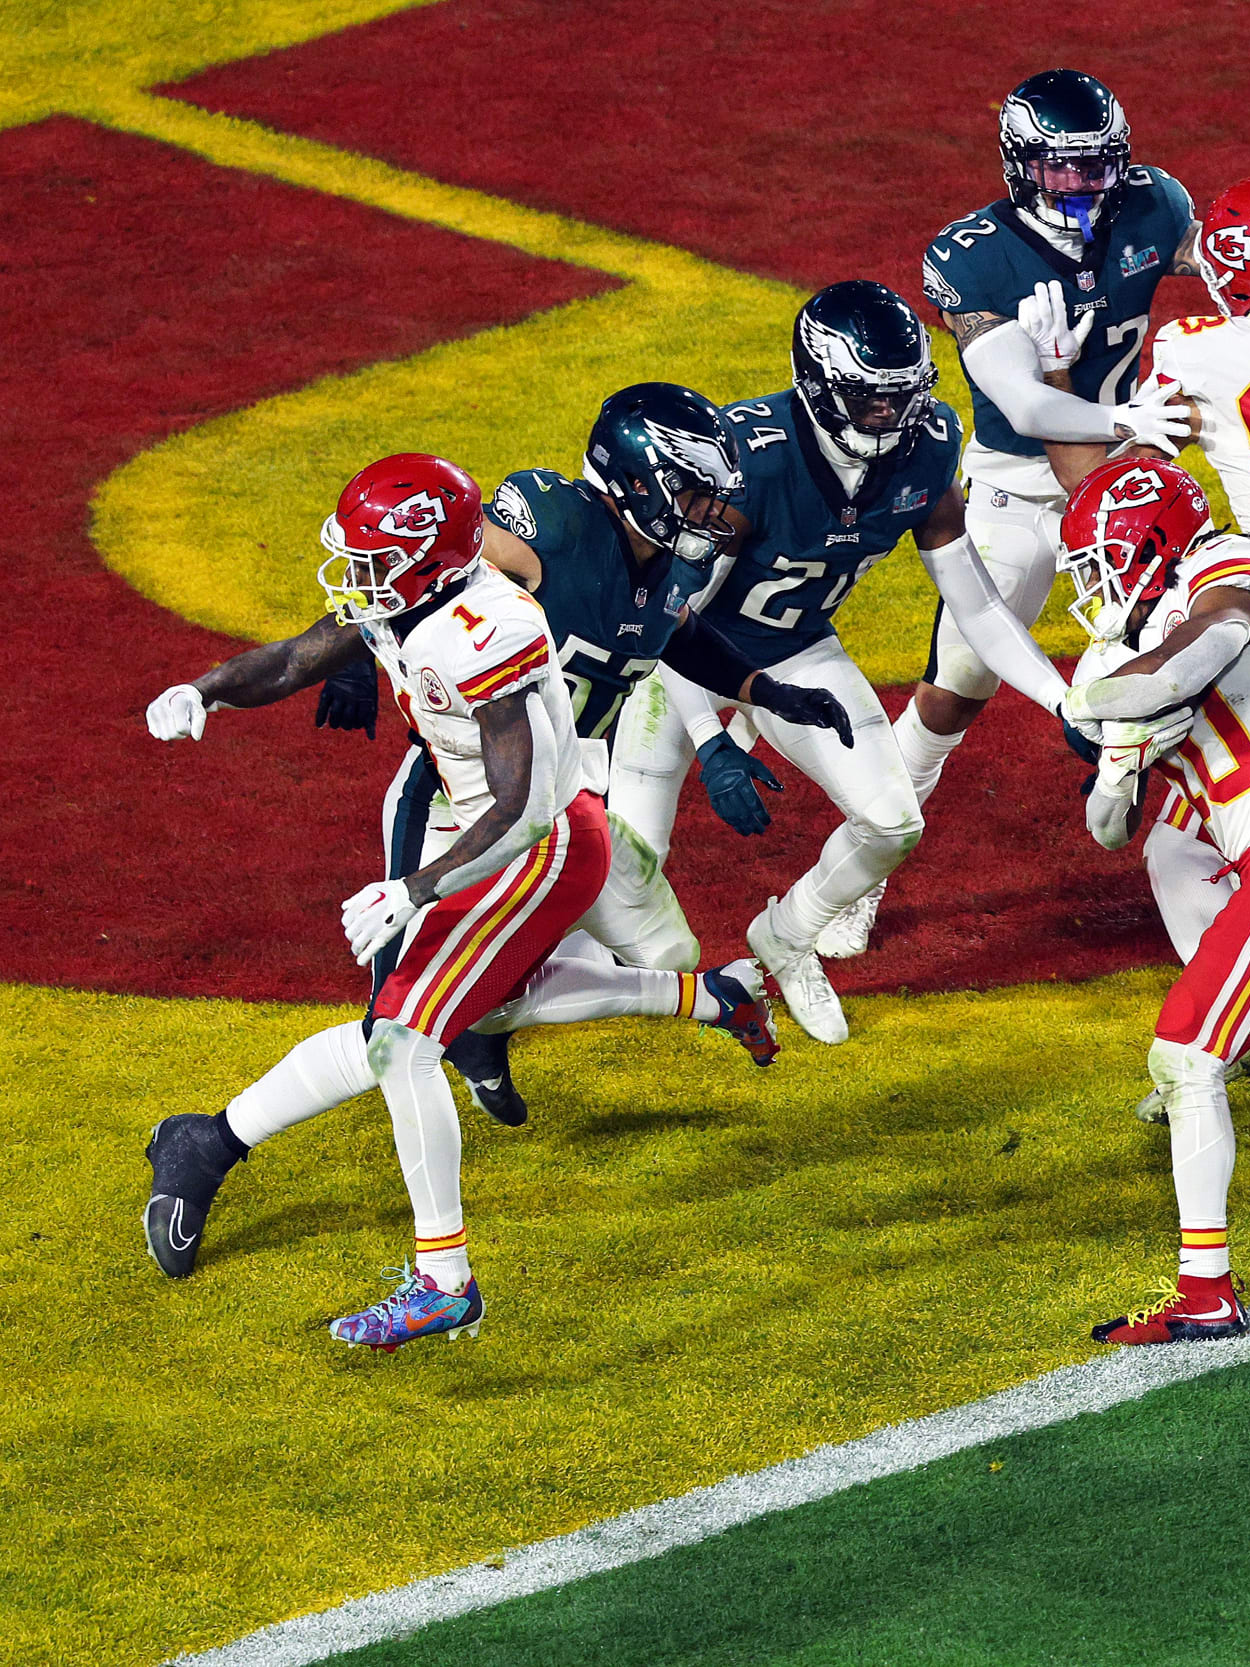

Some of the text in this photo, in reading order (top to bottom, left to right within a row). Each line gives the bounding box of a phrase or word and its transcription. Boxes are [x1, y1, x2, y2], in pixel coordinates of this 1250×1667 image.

[725, 402, 788, 451] 24
[824, 532, 861, 547] EAGLES
[451, 603, 486, 635] 1
